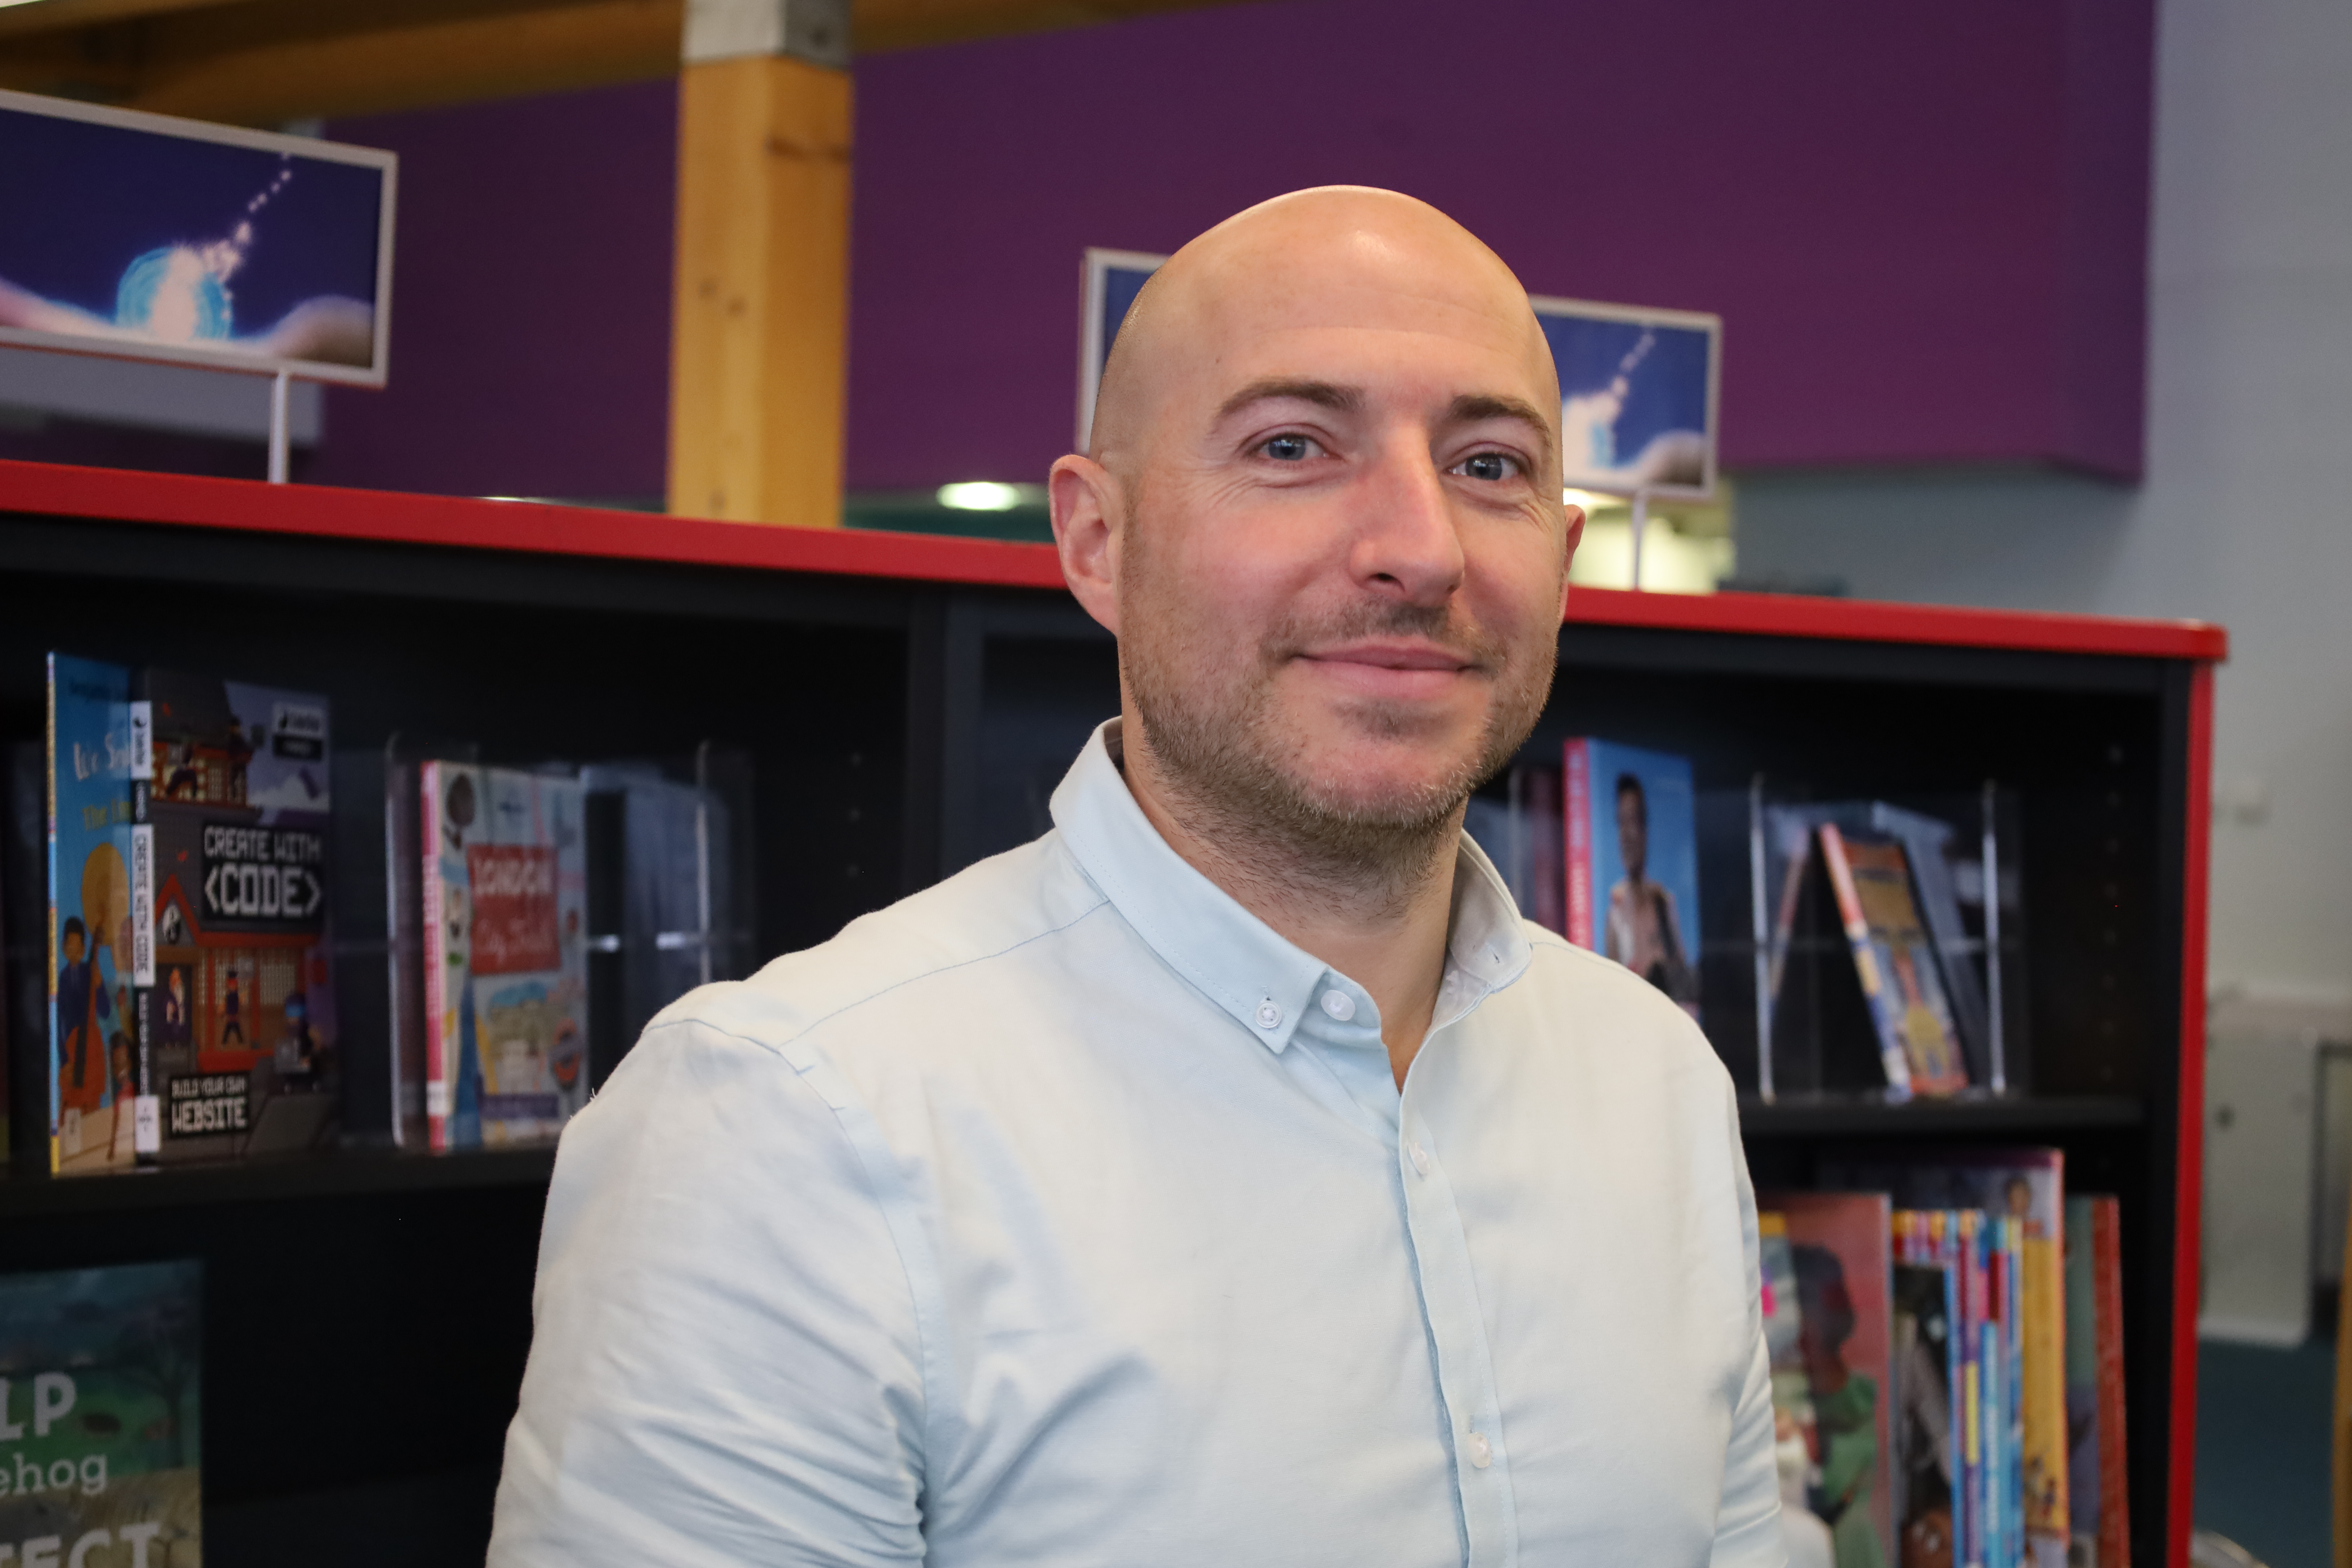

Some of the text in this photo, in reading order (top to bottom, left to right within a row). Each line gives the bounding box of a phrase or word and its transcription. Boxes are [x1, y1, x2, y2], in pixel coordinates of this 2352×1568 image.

[205, 826, 320, 863] CREATE WITH
[172, 1079, 198, 1098] BUILD
[200, 1076, 224, 1096] YOUR
[172, 1096, 247, 1133] WEBSITE
[0, 1521, 160, 1568] ECT
